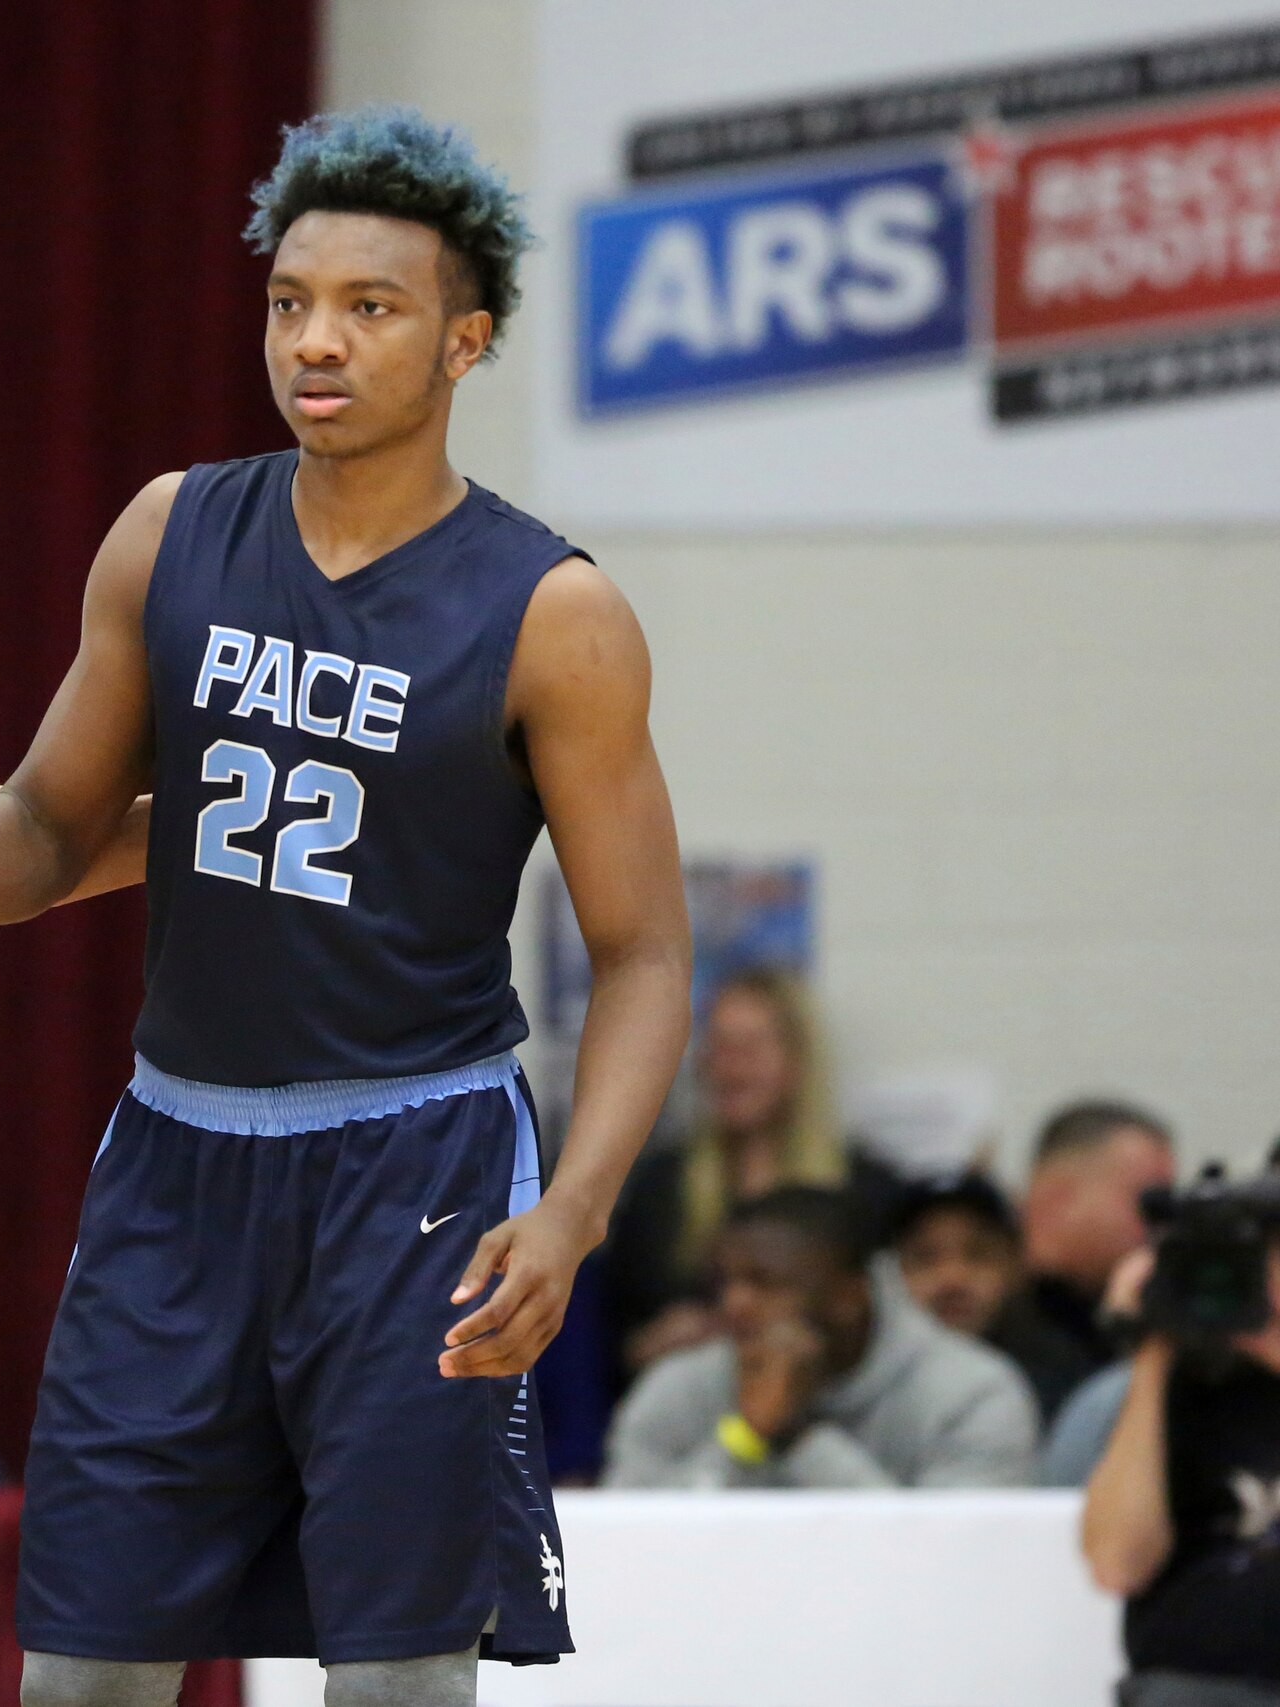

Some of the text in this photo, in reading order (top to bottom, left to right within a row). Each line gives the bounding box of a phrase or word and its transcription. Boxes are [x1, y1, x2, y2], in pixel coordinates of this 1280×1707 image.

[606, 185, 948, 370] ARS
[193, 625, 412, 753] PACE
[193, 738, 366, 907] 22
